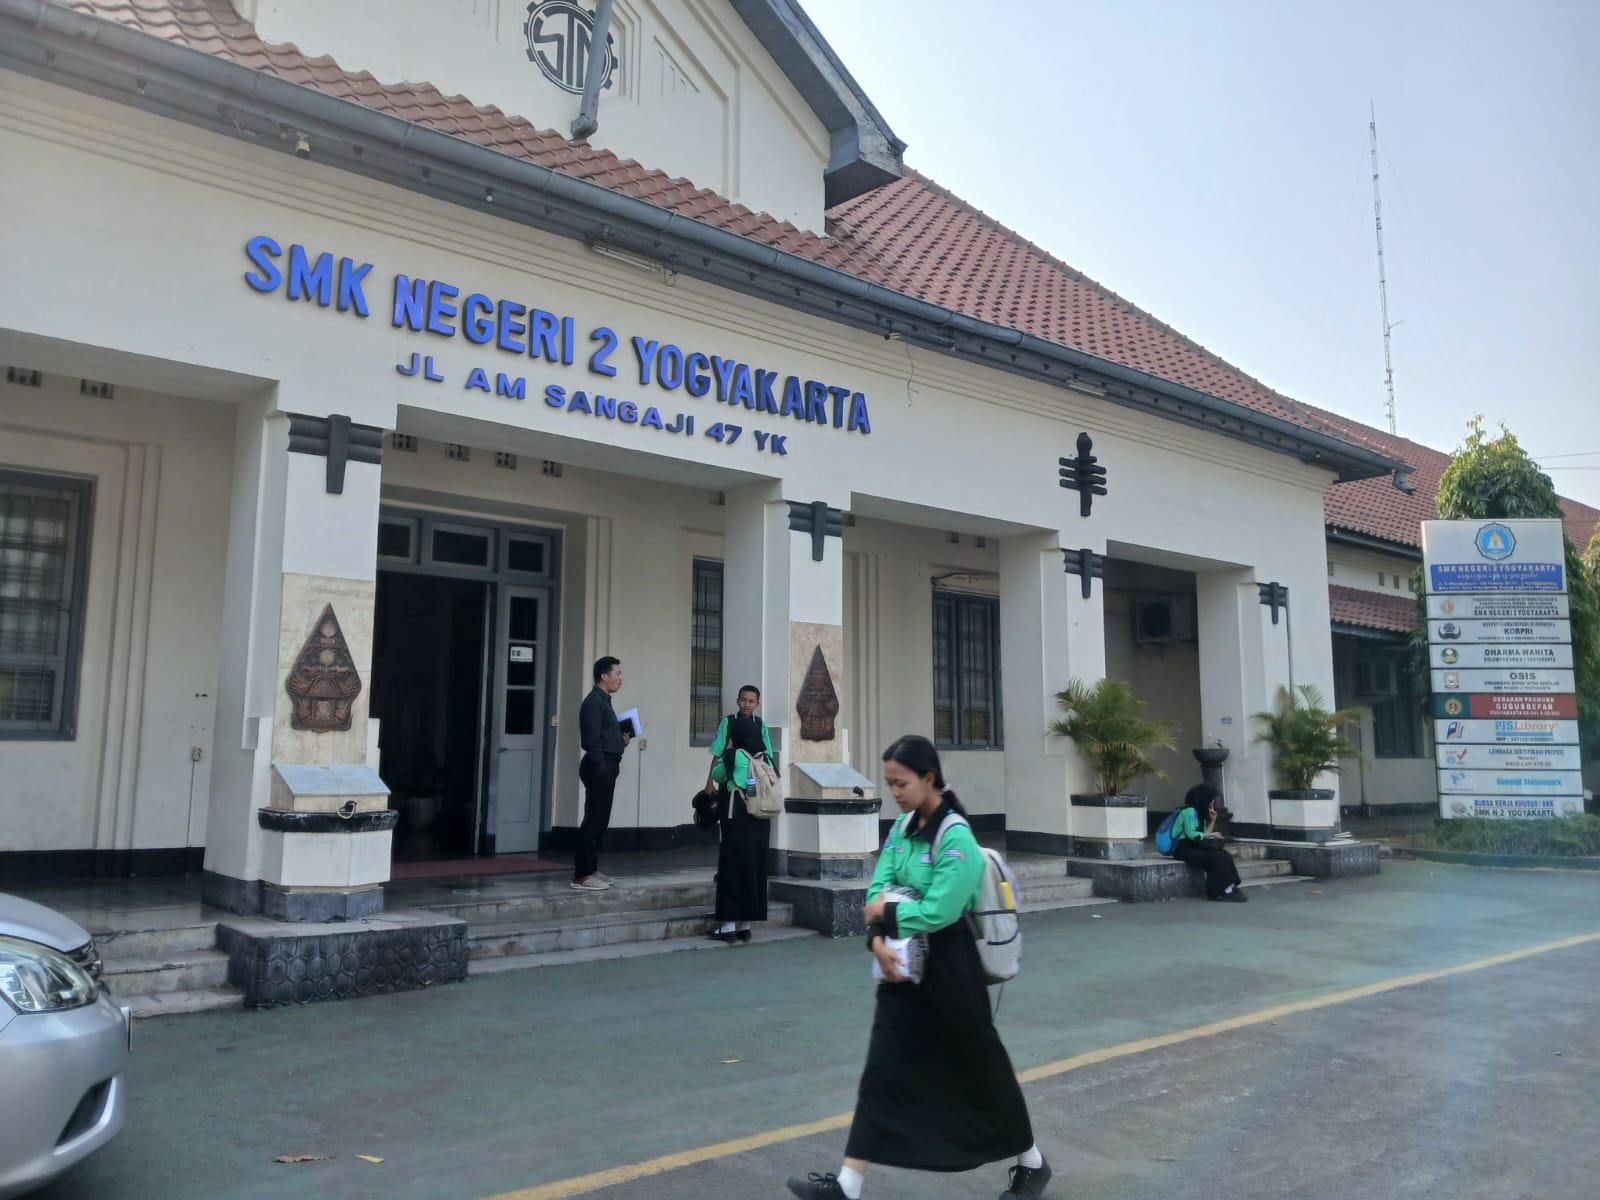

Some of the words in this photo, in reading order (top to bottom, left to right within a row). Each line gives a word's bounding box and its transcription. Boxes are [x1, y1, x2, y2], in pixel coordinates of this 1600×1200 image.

[245, 235, 374, 317] SMK
[392, 274, 574, 366] NEGERI
[589, 326, 618, 378] 2
[632, 335, 871, 435] YOGYAKARTA
[396, 352, 445, 382] JL
[465, 367, 526, 400] AM
[545, 384, 695, 436] SANGAJI
[705, 422, 742, 445] 47
[754, 430, 788, 456] YK
[1509, 672, 1536, 680] OSIS
[1474, 799, 1493, 807] BURSA
[1495, 799, 1513, 807] KERJA
[1508, 809, 1555, 817] YOGYAKARTA
